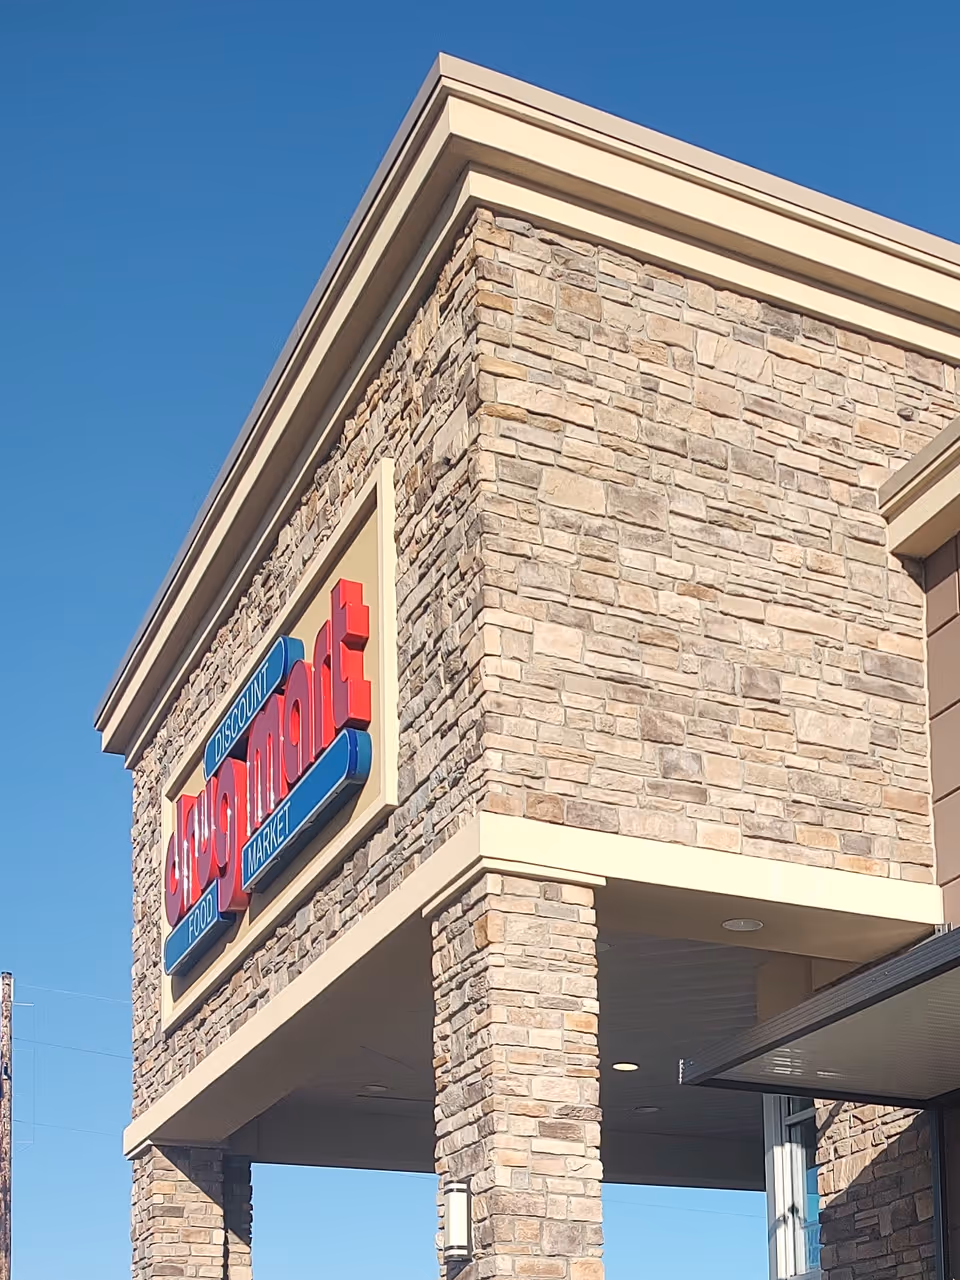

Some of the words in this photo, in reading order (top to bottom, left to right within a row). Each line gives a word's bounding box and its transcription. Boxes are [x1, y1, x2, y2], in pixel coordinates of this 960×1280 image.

[164, 757, 249, 928] drug
[246, 577, 372, 836] mart
[214, 662, 269, 763] DISCOUNT
[187, 893, 213, 944] FOOD
[247, 800, 291, 876] MARKET
